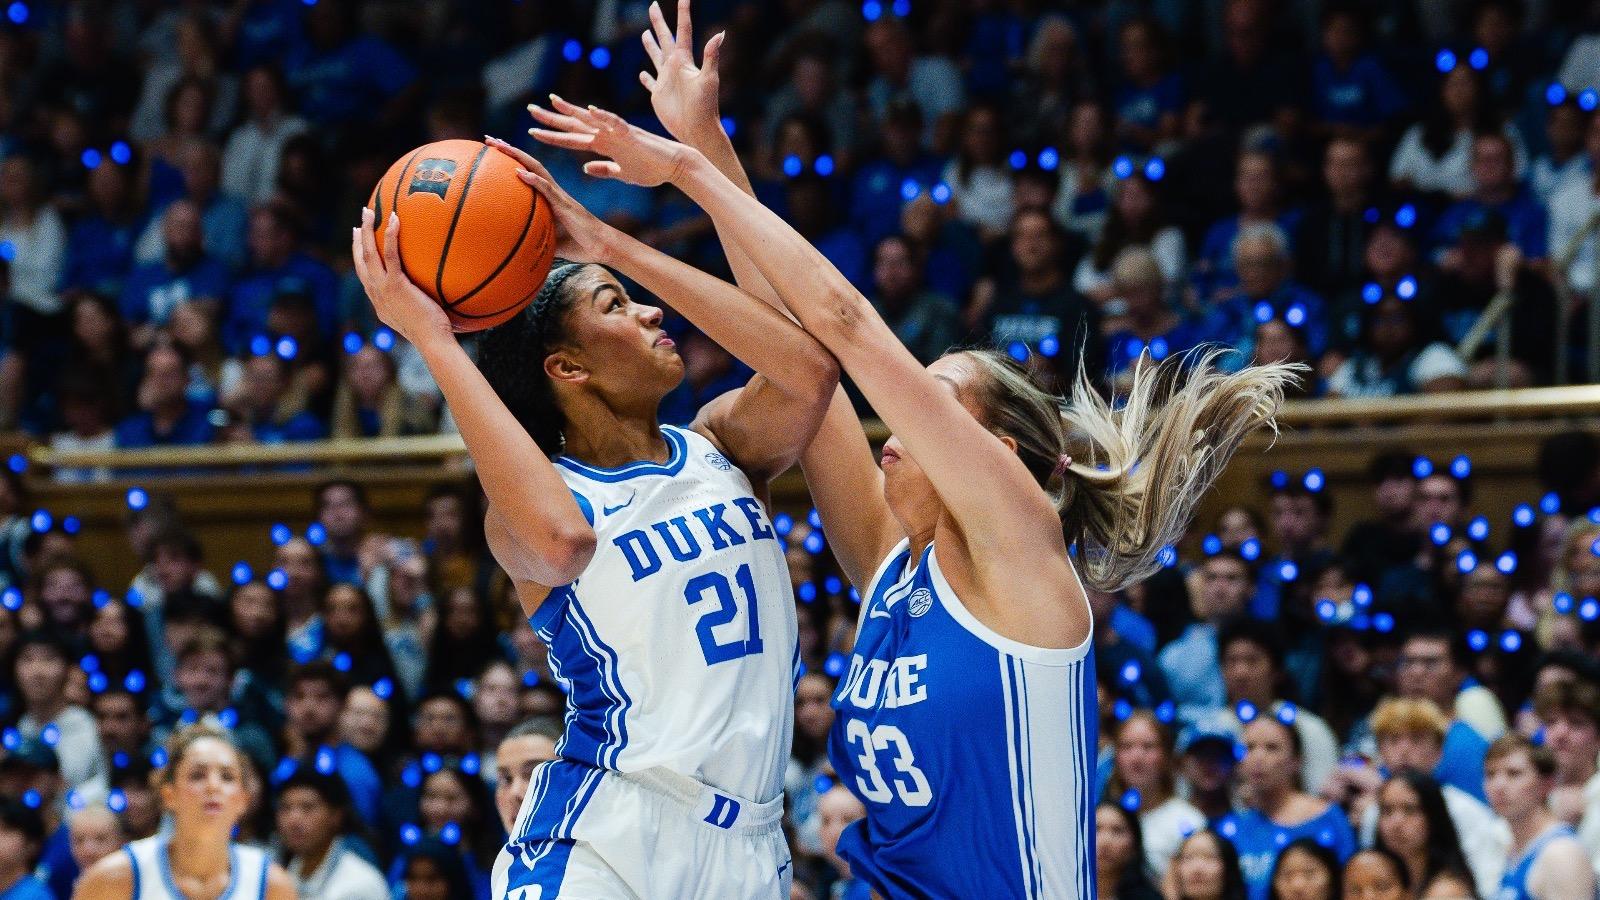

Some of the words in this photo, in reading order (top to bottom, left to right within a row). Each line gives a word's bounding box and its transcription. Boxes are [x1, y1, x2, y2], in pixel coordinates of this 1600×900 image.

[613, 497, 774, 582] DUKE
[684, 564, 763, 666] 21
[847, 718, 932, 806] 33
[703, 794, 740, 829] D
